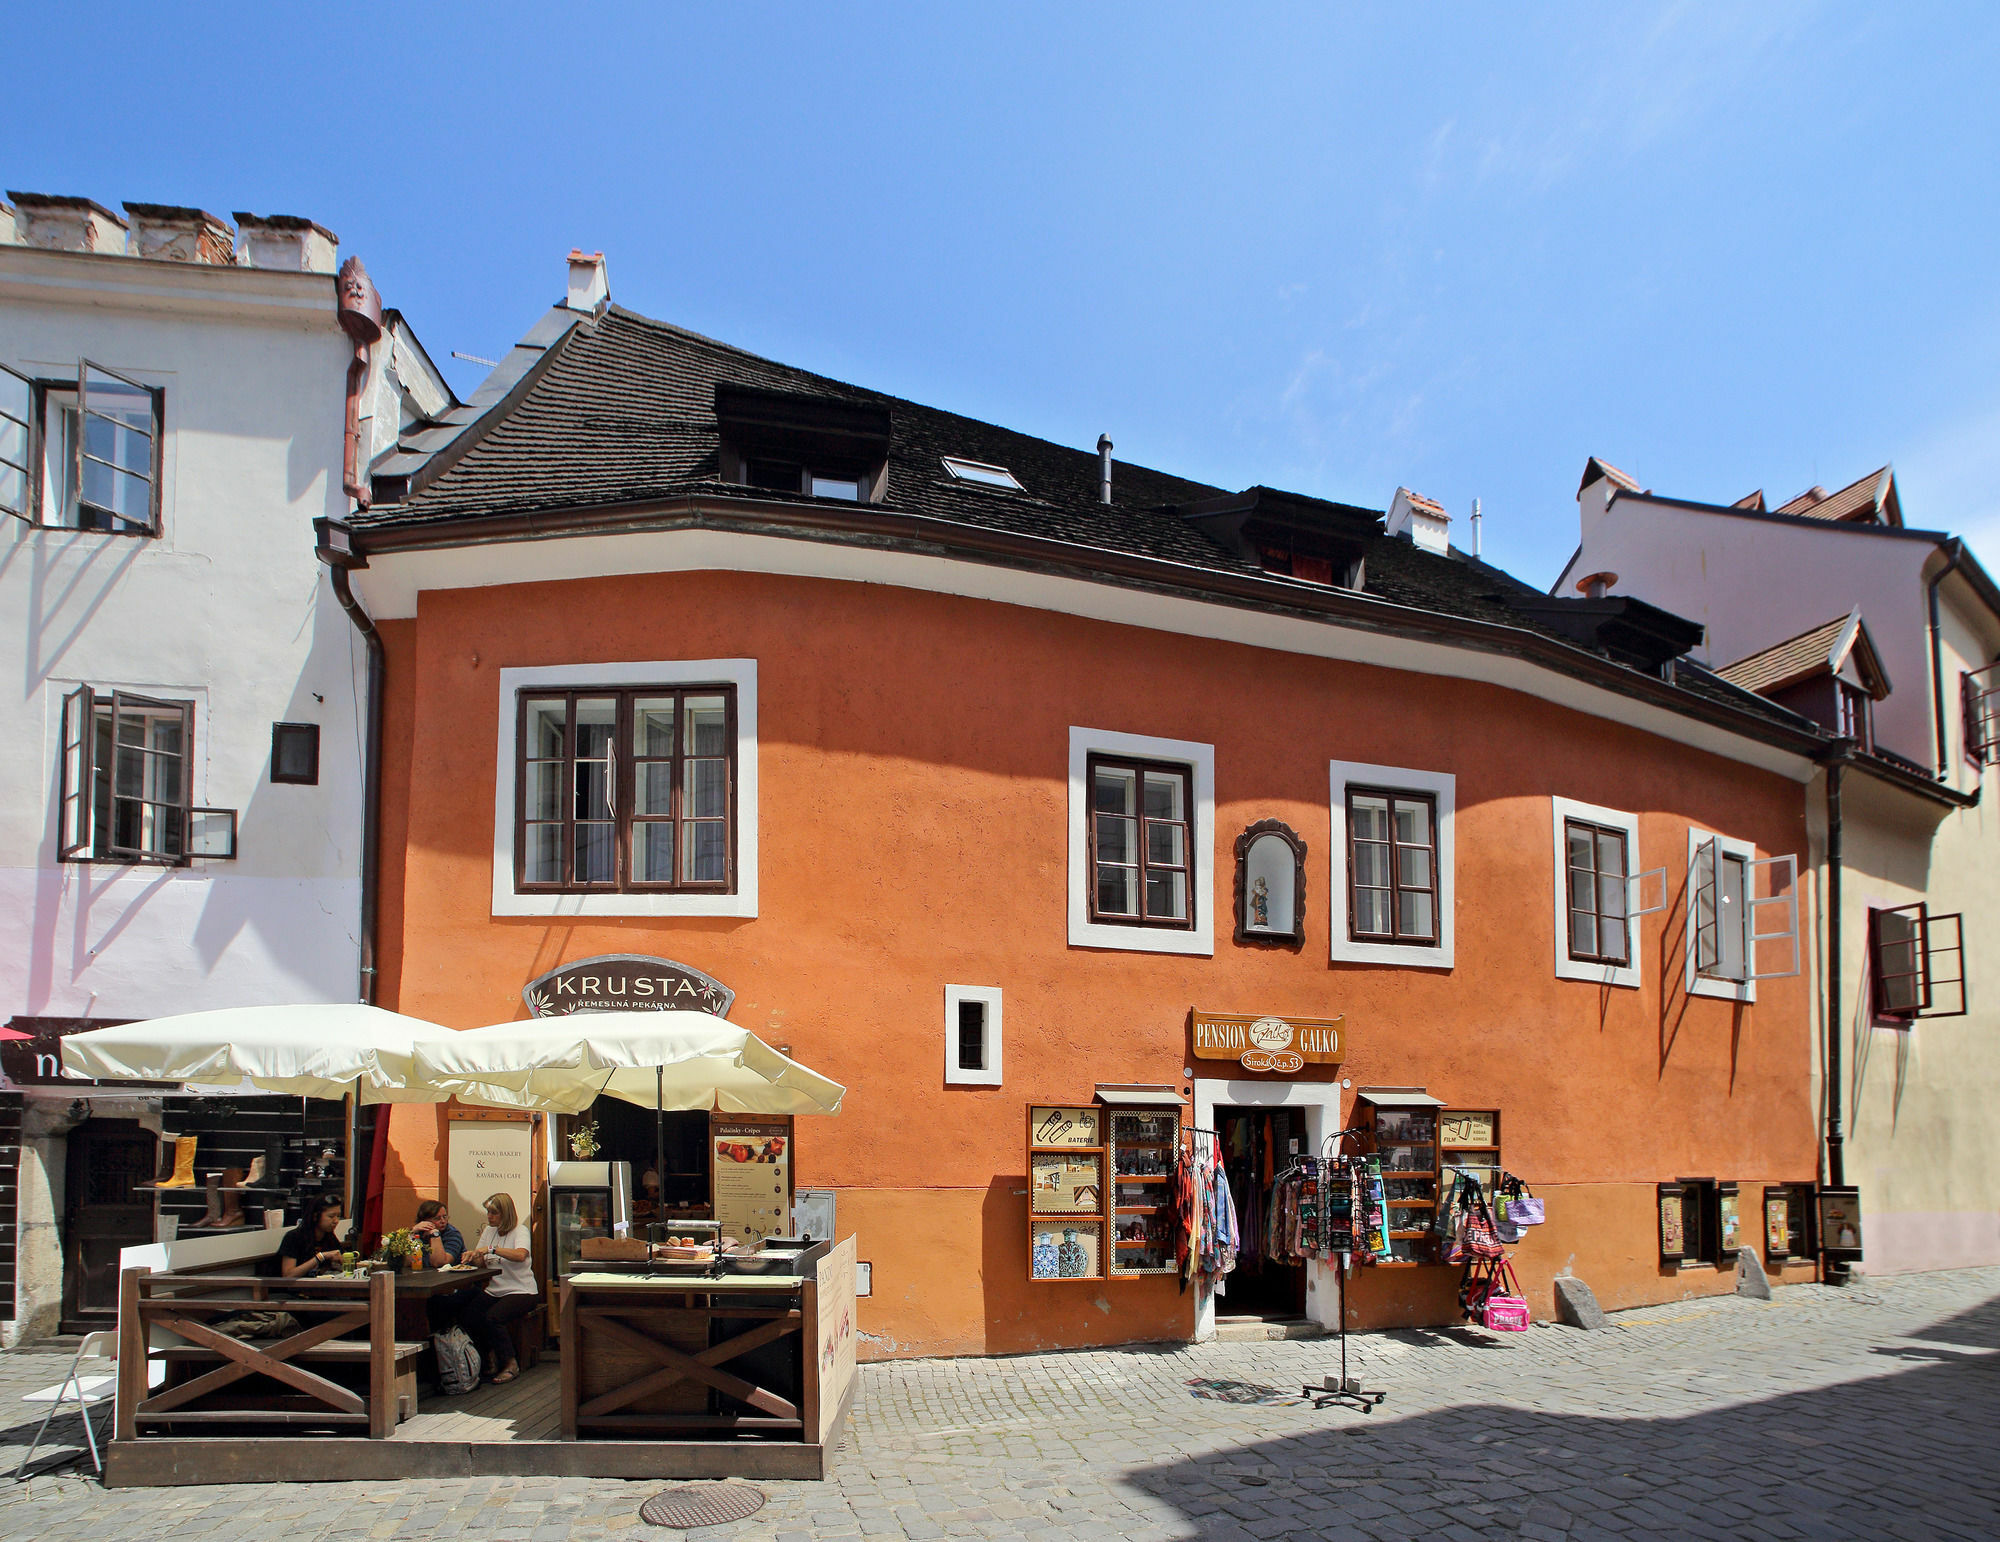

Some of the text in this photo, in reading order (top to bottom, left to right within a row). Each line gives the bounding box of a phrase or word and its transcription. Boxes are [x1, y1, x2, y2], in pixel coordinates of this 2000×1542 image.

[556, 976, 698, 997] KRUSTA
[577, 999, 677, 1009] ŘEMESLNÁ PEKÁRNA
[1196, 1023, 1338, 1053] PENSION GALKO
[1245, 1054, 1299, 1070] Široká č.p. 53
[719, 1127, 741, 1135] Palačinky
[744, 1127, 761, 1135] Crêpes
[1067, 1136, 1094, 1144] BATERIE
[476, 1160, 486, 1169] &
[1494, 1313, 1523, 1326] PRAGUE
